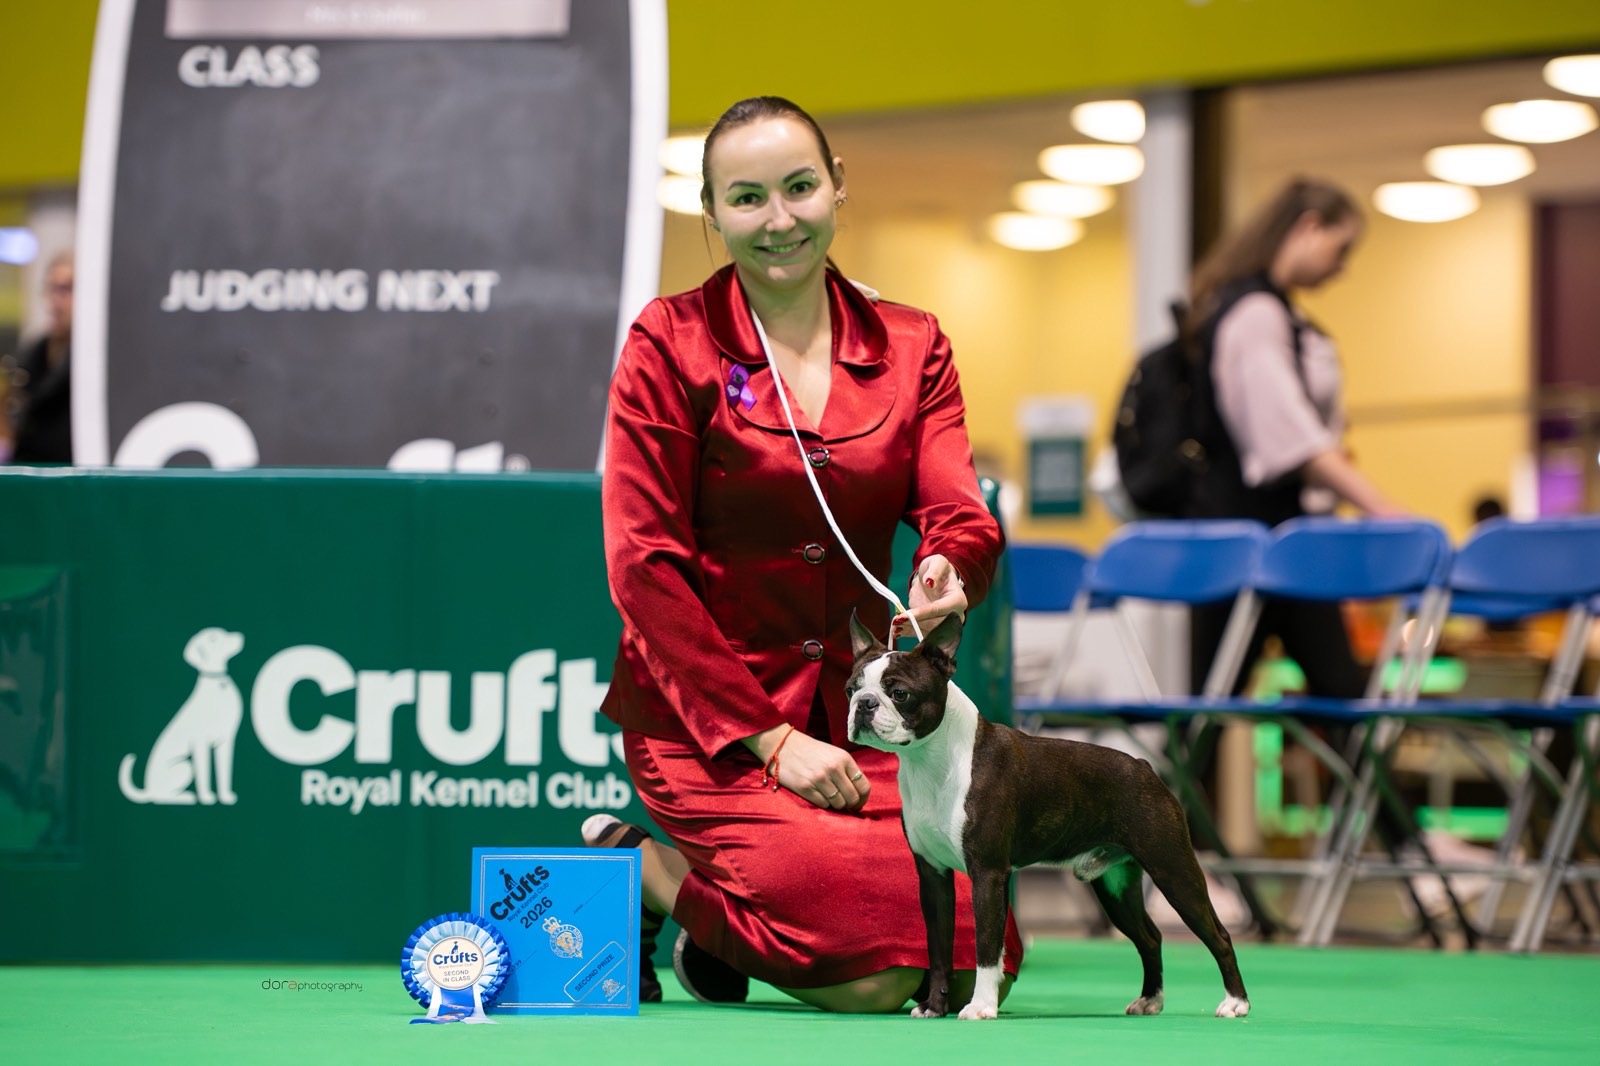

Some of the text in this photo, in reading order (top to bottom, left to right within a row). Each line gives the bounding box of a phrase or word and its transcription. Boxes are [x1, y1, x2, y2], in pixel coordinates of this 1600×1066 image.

[178, 45, 320, 88] CLASS
[161, 268, 499, 313] JUDGING NEXT
[250, 644, 627, 767] Cruft
[300, 769, 631, 815] Royal Kennel Club
[490, 865, 550, 920] Crufts
[520, 896, 553, 929] 2026
[433, 952, 478, 965] Crufts
[444, 969, 469, 977] SECOND
[575, 954, 615, 992] SECOND PRIZE
